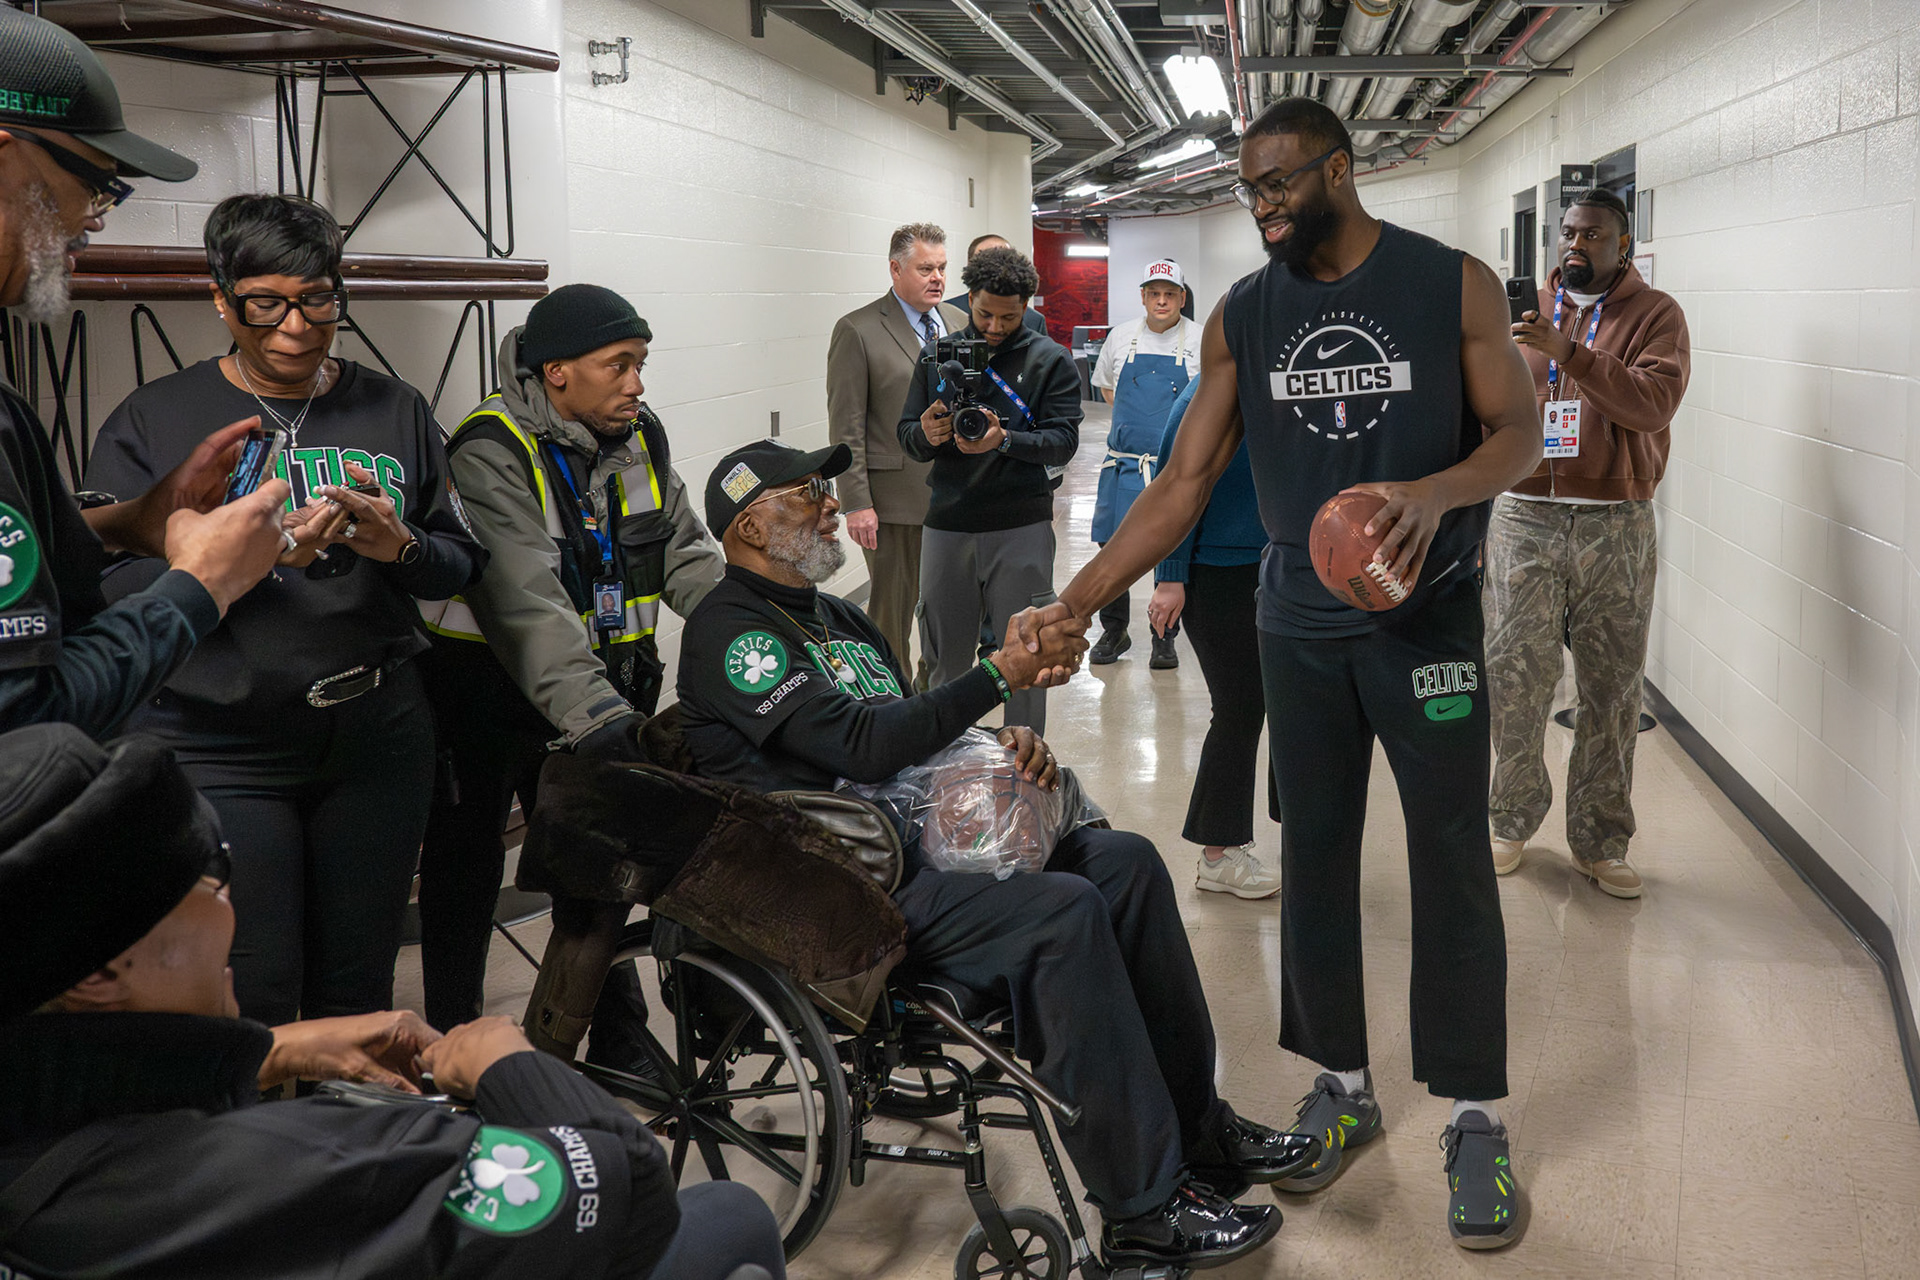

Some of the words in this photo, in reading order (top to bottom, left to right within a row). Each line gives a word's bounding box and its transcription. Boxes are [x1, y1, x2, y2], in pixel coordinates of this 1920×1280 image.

[1149, 263, 1173, 277] ROSE
[1276, 322, 1310, 369] BOSTON
[1322, 311, 1400, 359] BASKETBALL
[1286, 366, 1392, 396] CELTICS
[0, 615, 47, 638] MPS
[729, 636, 773, 675] CELTICS
[770, 672, 809, 704] CHAMPS
[1412, 662, 1478, 699] CELTICS
